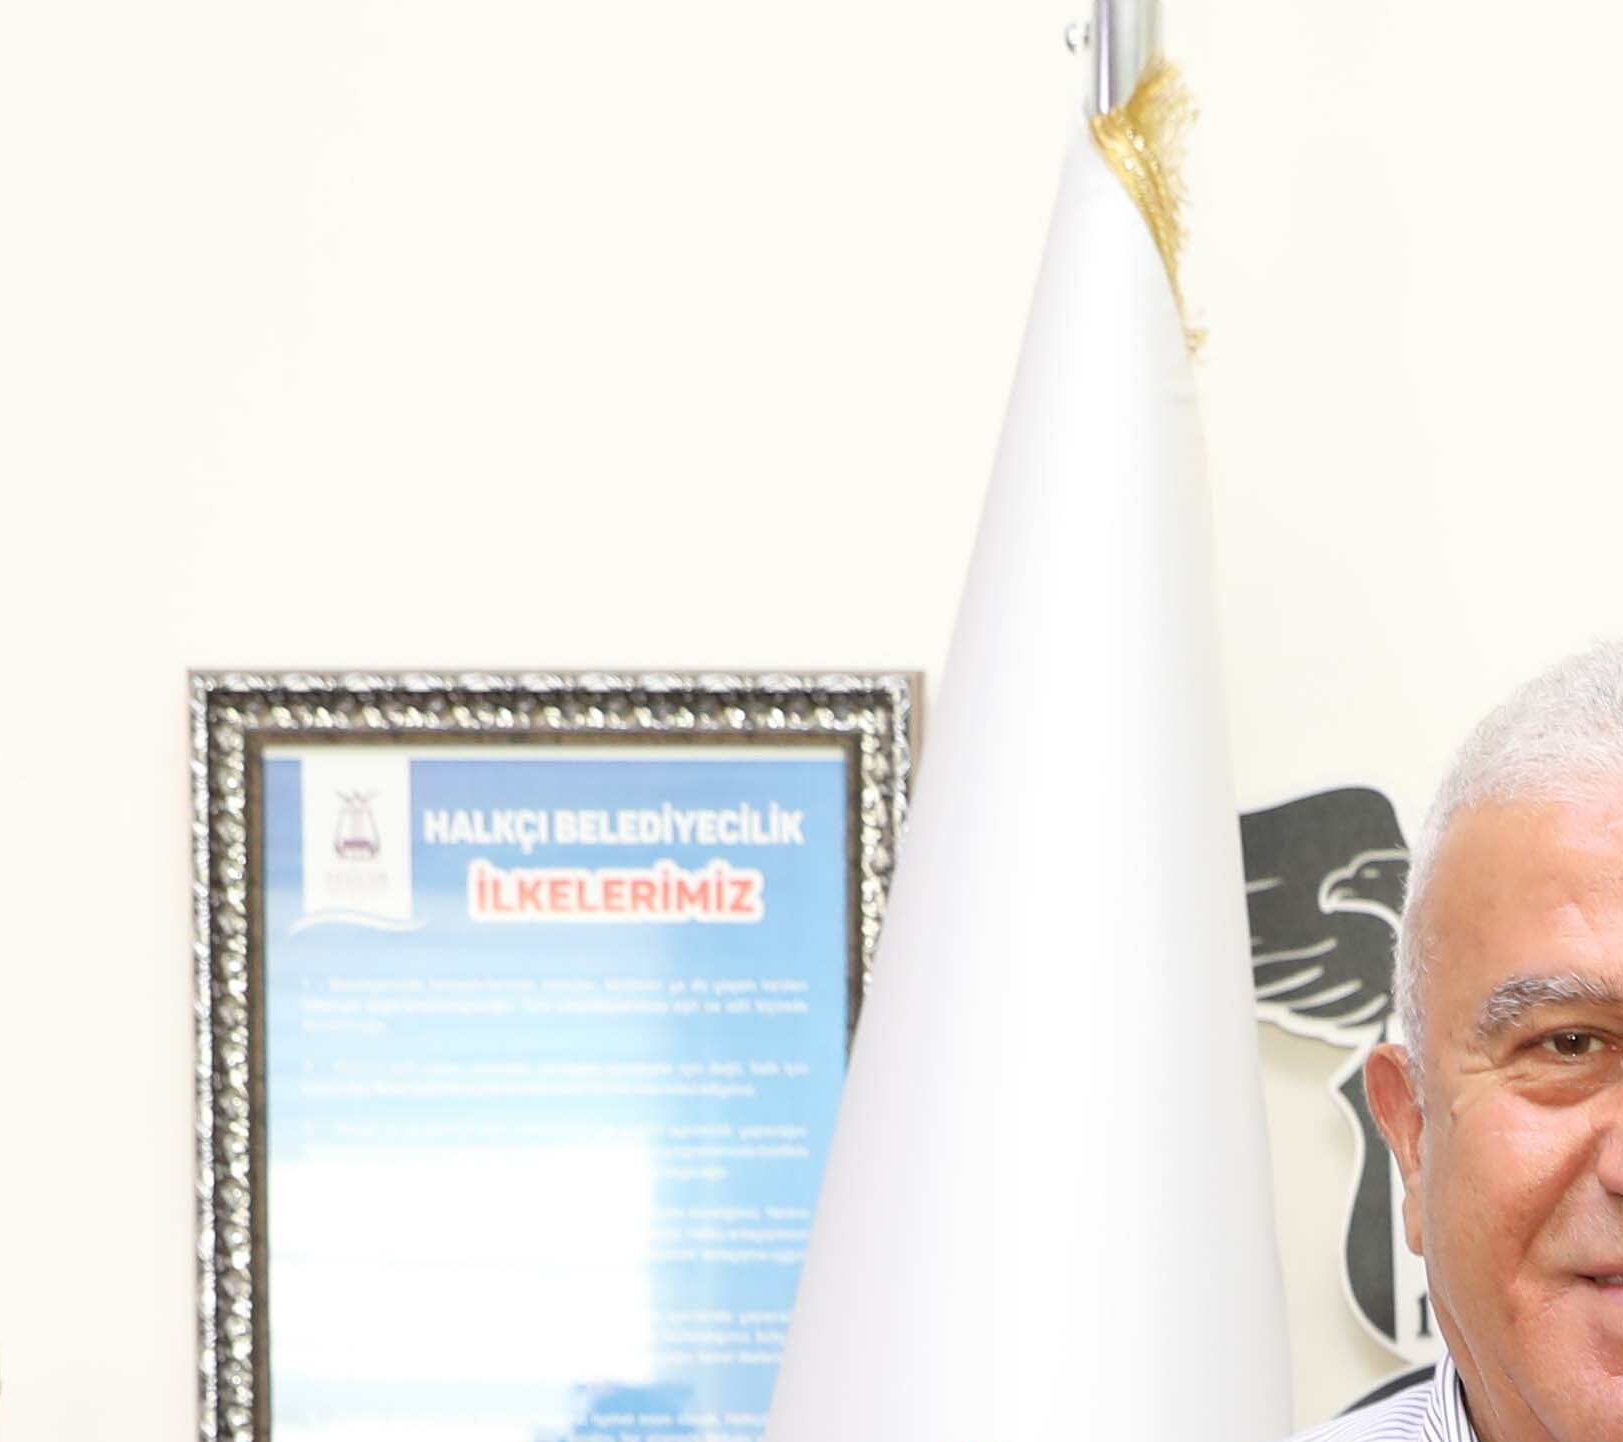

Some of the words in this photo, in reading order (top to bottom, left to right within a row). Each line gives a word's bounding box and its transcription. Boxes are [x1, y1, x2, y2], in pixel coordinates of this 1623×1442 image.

[423, 809, 548, 853] HALKÇI
[555, 801, 805, 845] BELEDİYECİLİK
[475, 867, 756, 914] İLKELERİMİZ
